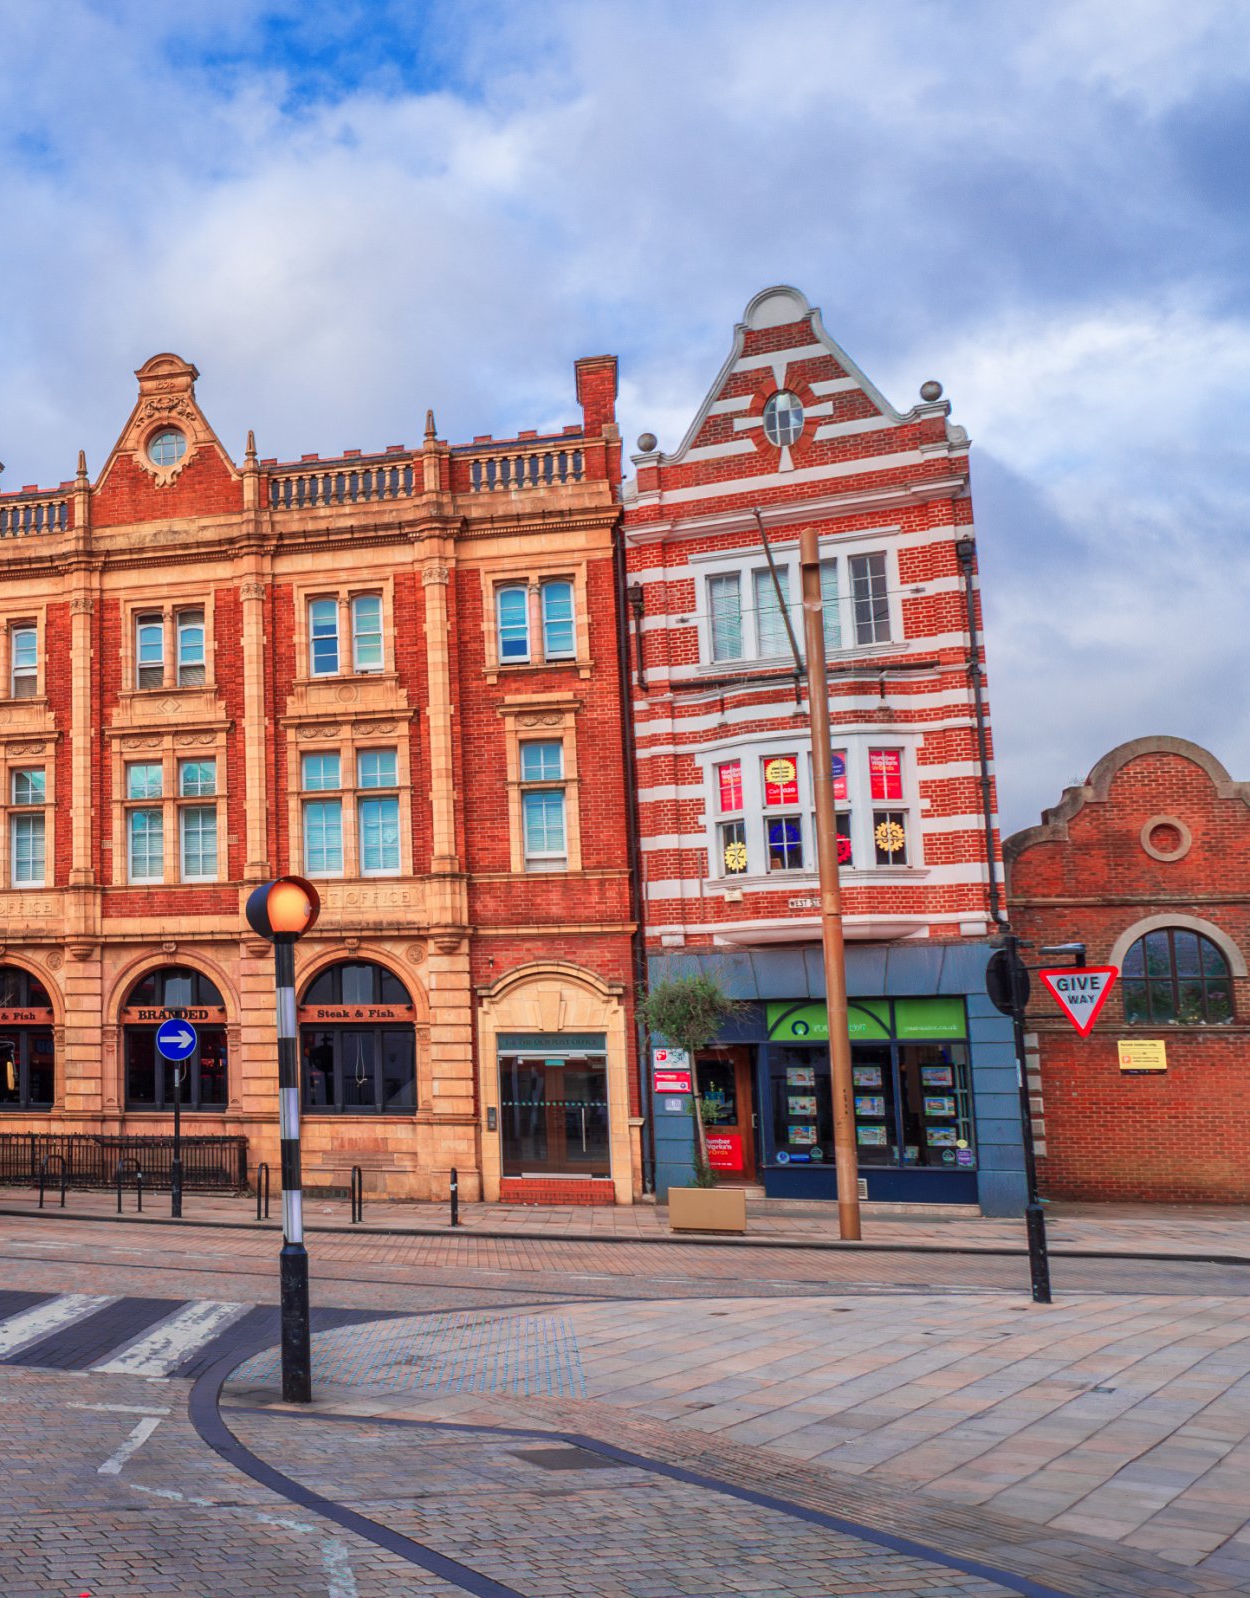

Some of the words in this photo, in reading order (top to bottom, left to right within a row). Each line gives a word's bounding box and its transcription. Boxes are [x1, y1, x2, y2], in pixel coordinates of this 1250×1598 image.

[346, 891, 411, 904] OFFICE
[1056, 976, 1100, 992] GIVE
[1067, 994, 1095, 1005] WAY
[13, 1012, 36, 1020] Fish
[138, 1009, 209, 1020] BRANDED
[317, 1009, 350, 1018] Steak
[354, 1009, 364, 1018] &
[368, 1009, 395, 1018] Fish
